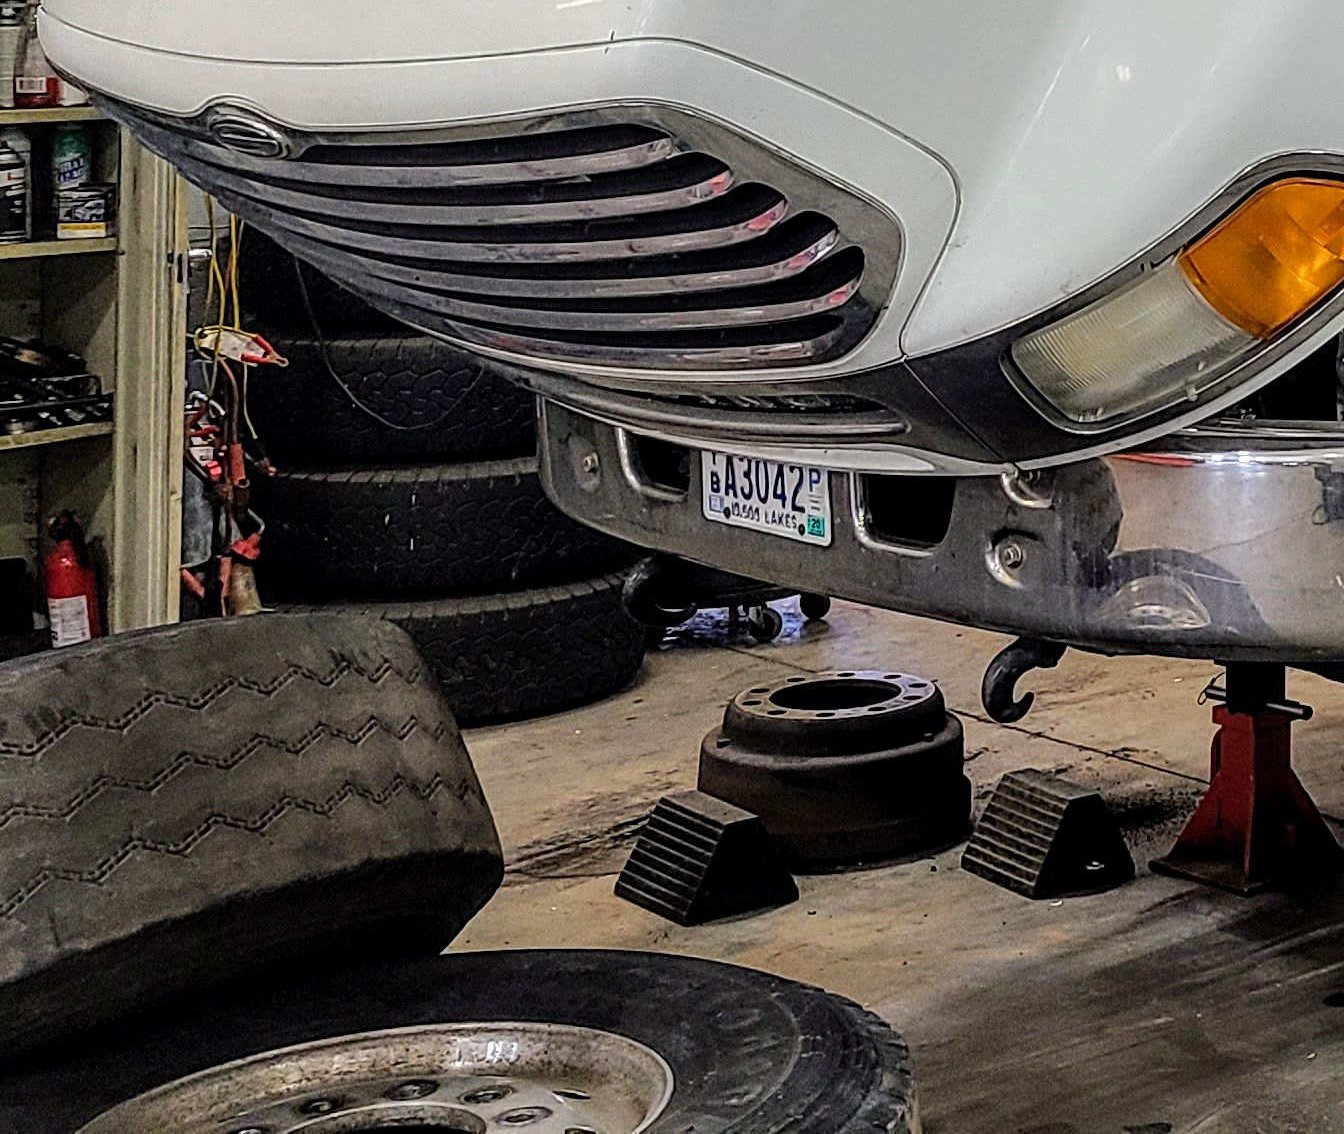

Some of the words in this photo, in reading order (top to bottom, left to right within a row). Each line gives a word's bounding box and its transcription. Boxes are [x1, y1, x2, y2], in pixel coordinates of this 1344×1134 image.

[724, 454, 806, 514] A3042
[808, 467, 821, 493] P
[764, 509, 797, 530] LAKES
